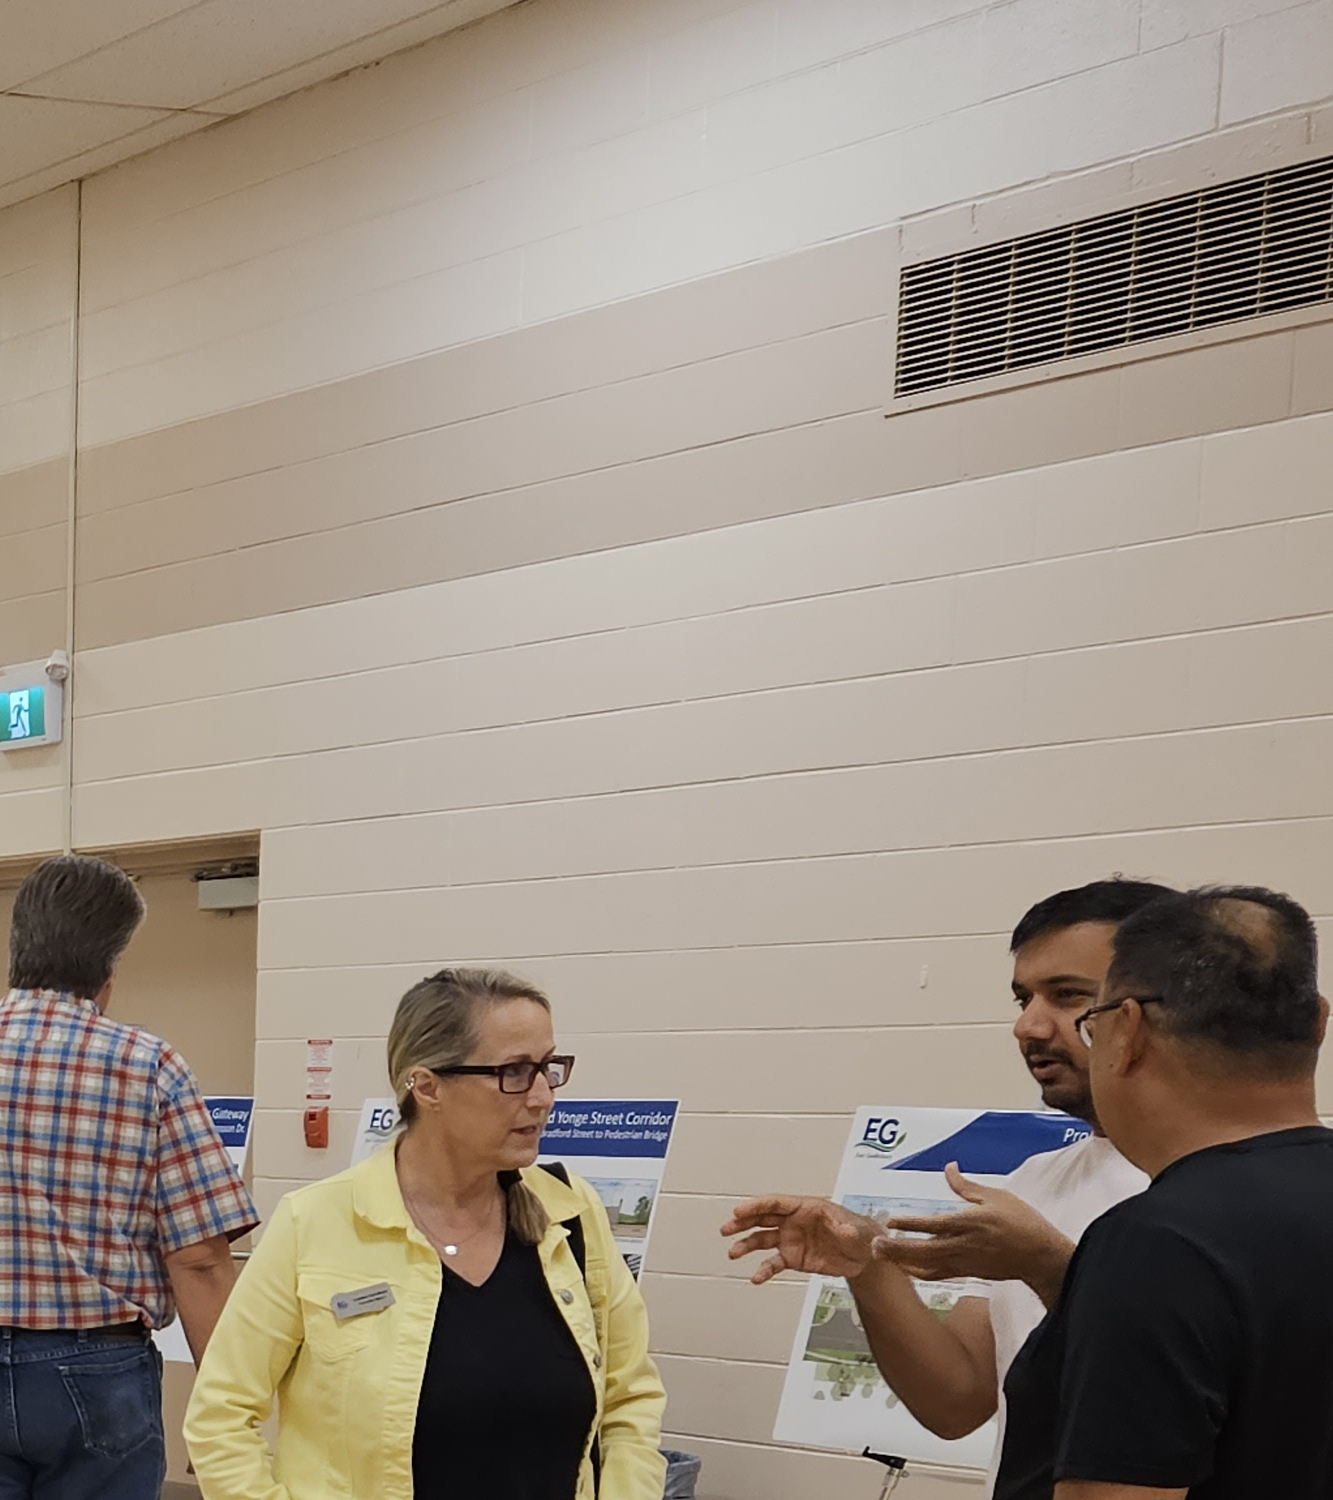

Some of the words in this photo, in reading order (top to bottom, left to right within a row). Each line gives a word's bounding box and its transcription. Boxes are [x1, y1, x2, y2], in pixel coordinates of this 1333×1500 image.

[211, 1107, 250, 1123] Gateway
[369, 1108, 395, 1130] EG
[557, 1111, 589, 1127] Yonge
[590, 1111, 624, 1125] Street
[625, 1111, 673, 1126] Corridor
[571, 1128, 594, 1139] Street
[594, 1129, 604, 1140] to
[604, 1129, 643, 1141] Pedestrian
[643, 1129, 669, 1143] Bridge
[863, 1118, 900, 1145] EG
[1063, 1127, 1094, 1143] Pro
